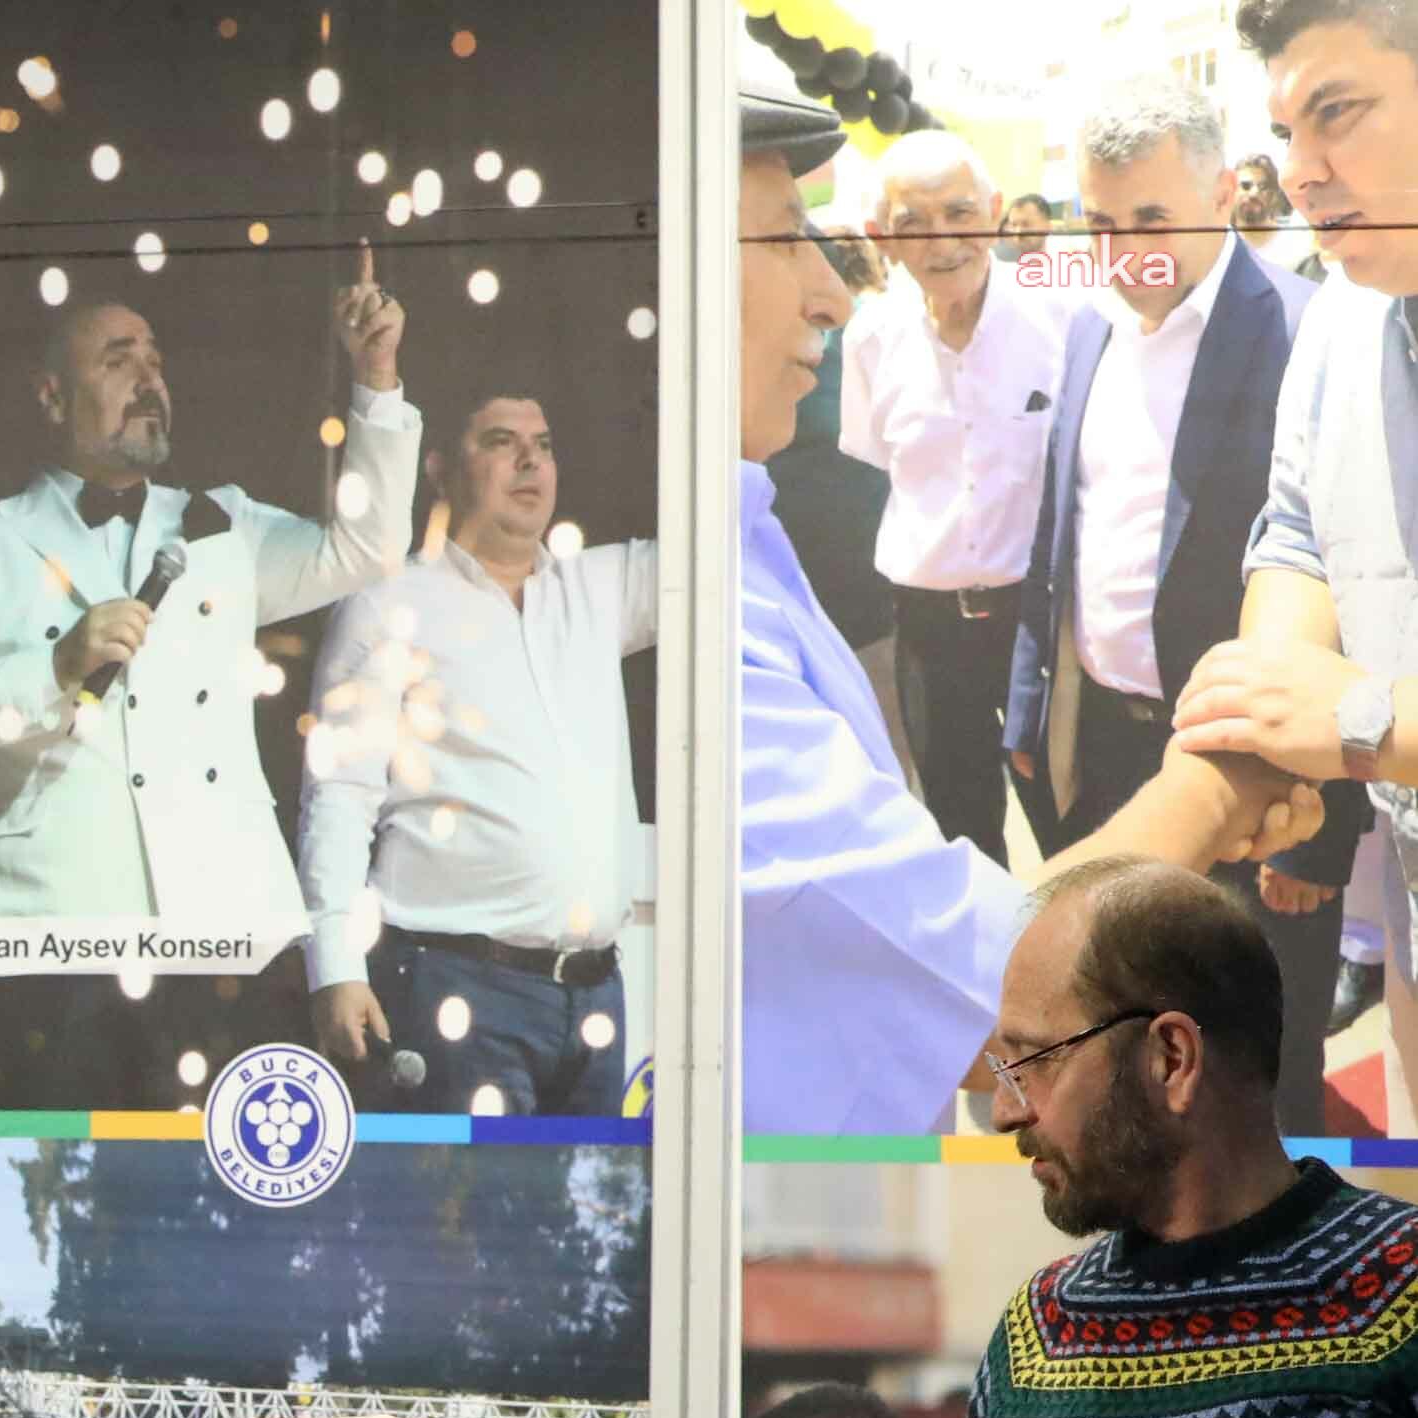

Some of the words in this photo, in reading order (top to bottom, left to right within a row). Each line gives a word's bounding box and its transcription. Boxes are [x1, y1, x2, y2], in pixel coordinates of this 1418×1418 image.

[39, 932, 127, 964] Aysev
[138, 932, 252, 958] Konseri
[239, 1057, 319, 1084] BUCA
[220, 1147, 339, 1195] BELEDİYESİ
